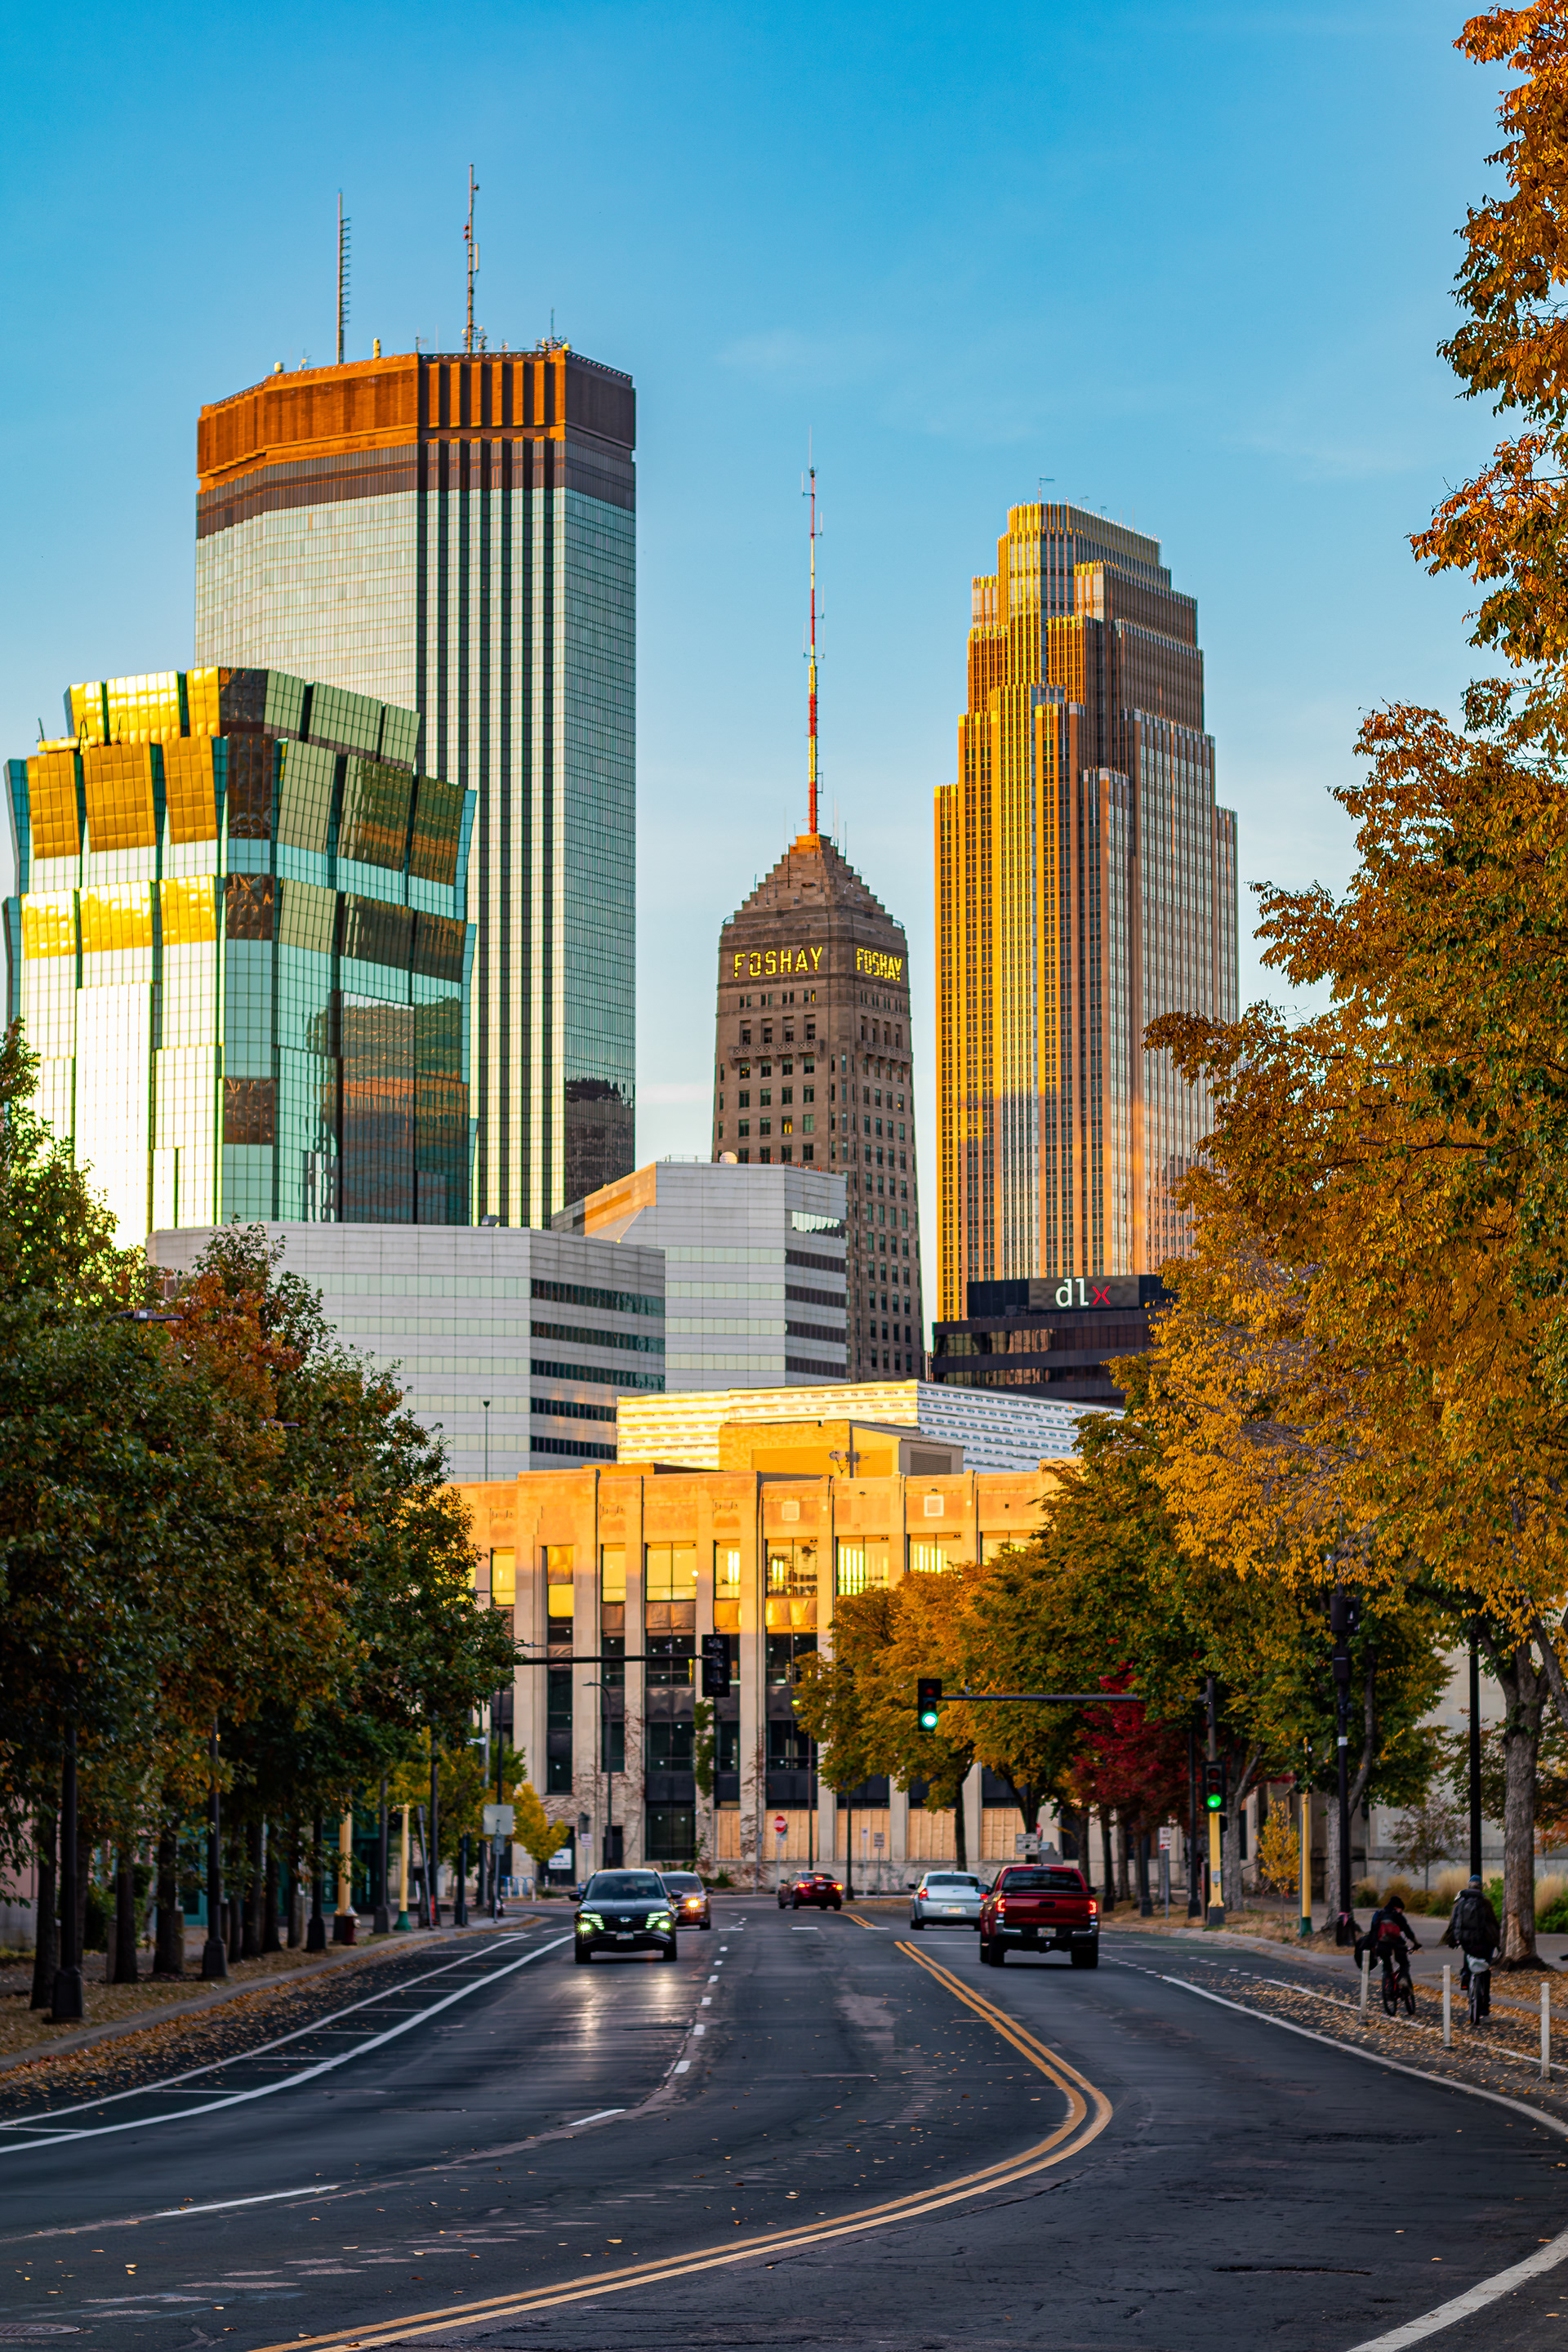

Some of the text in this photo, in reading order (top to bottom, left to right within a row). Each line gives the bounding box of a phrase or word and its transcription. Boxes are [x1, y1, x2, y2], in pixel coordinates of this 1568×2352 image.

[734, 947, 822, 978] FOSHAY
[857, 947, 902, 982] FOSHAY
[1055, 1277, 1111, 1307] dlx
